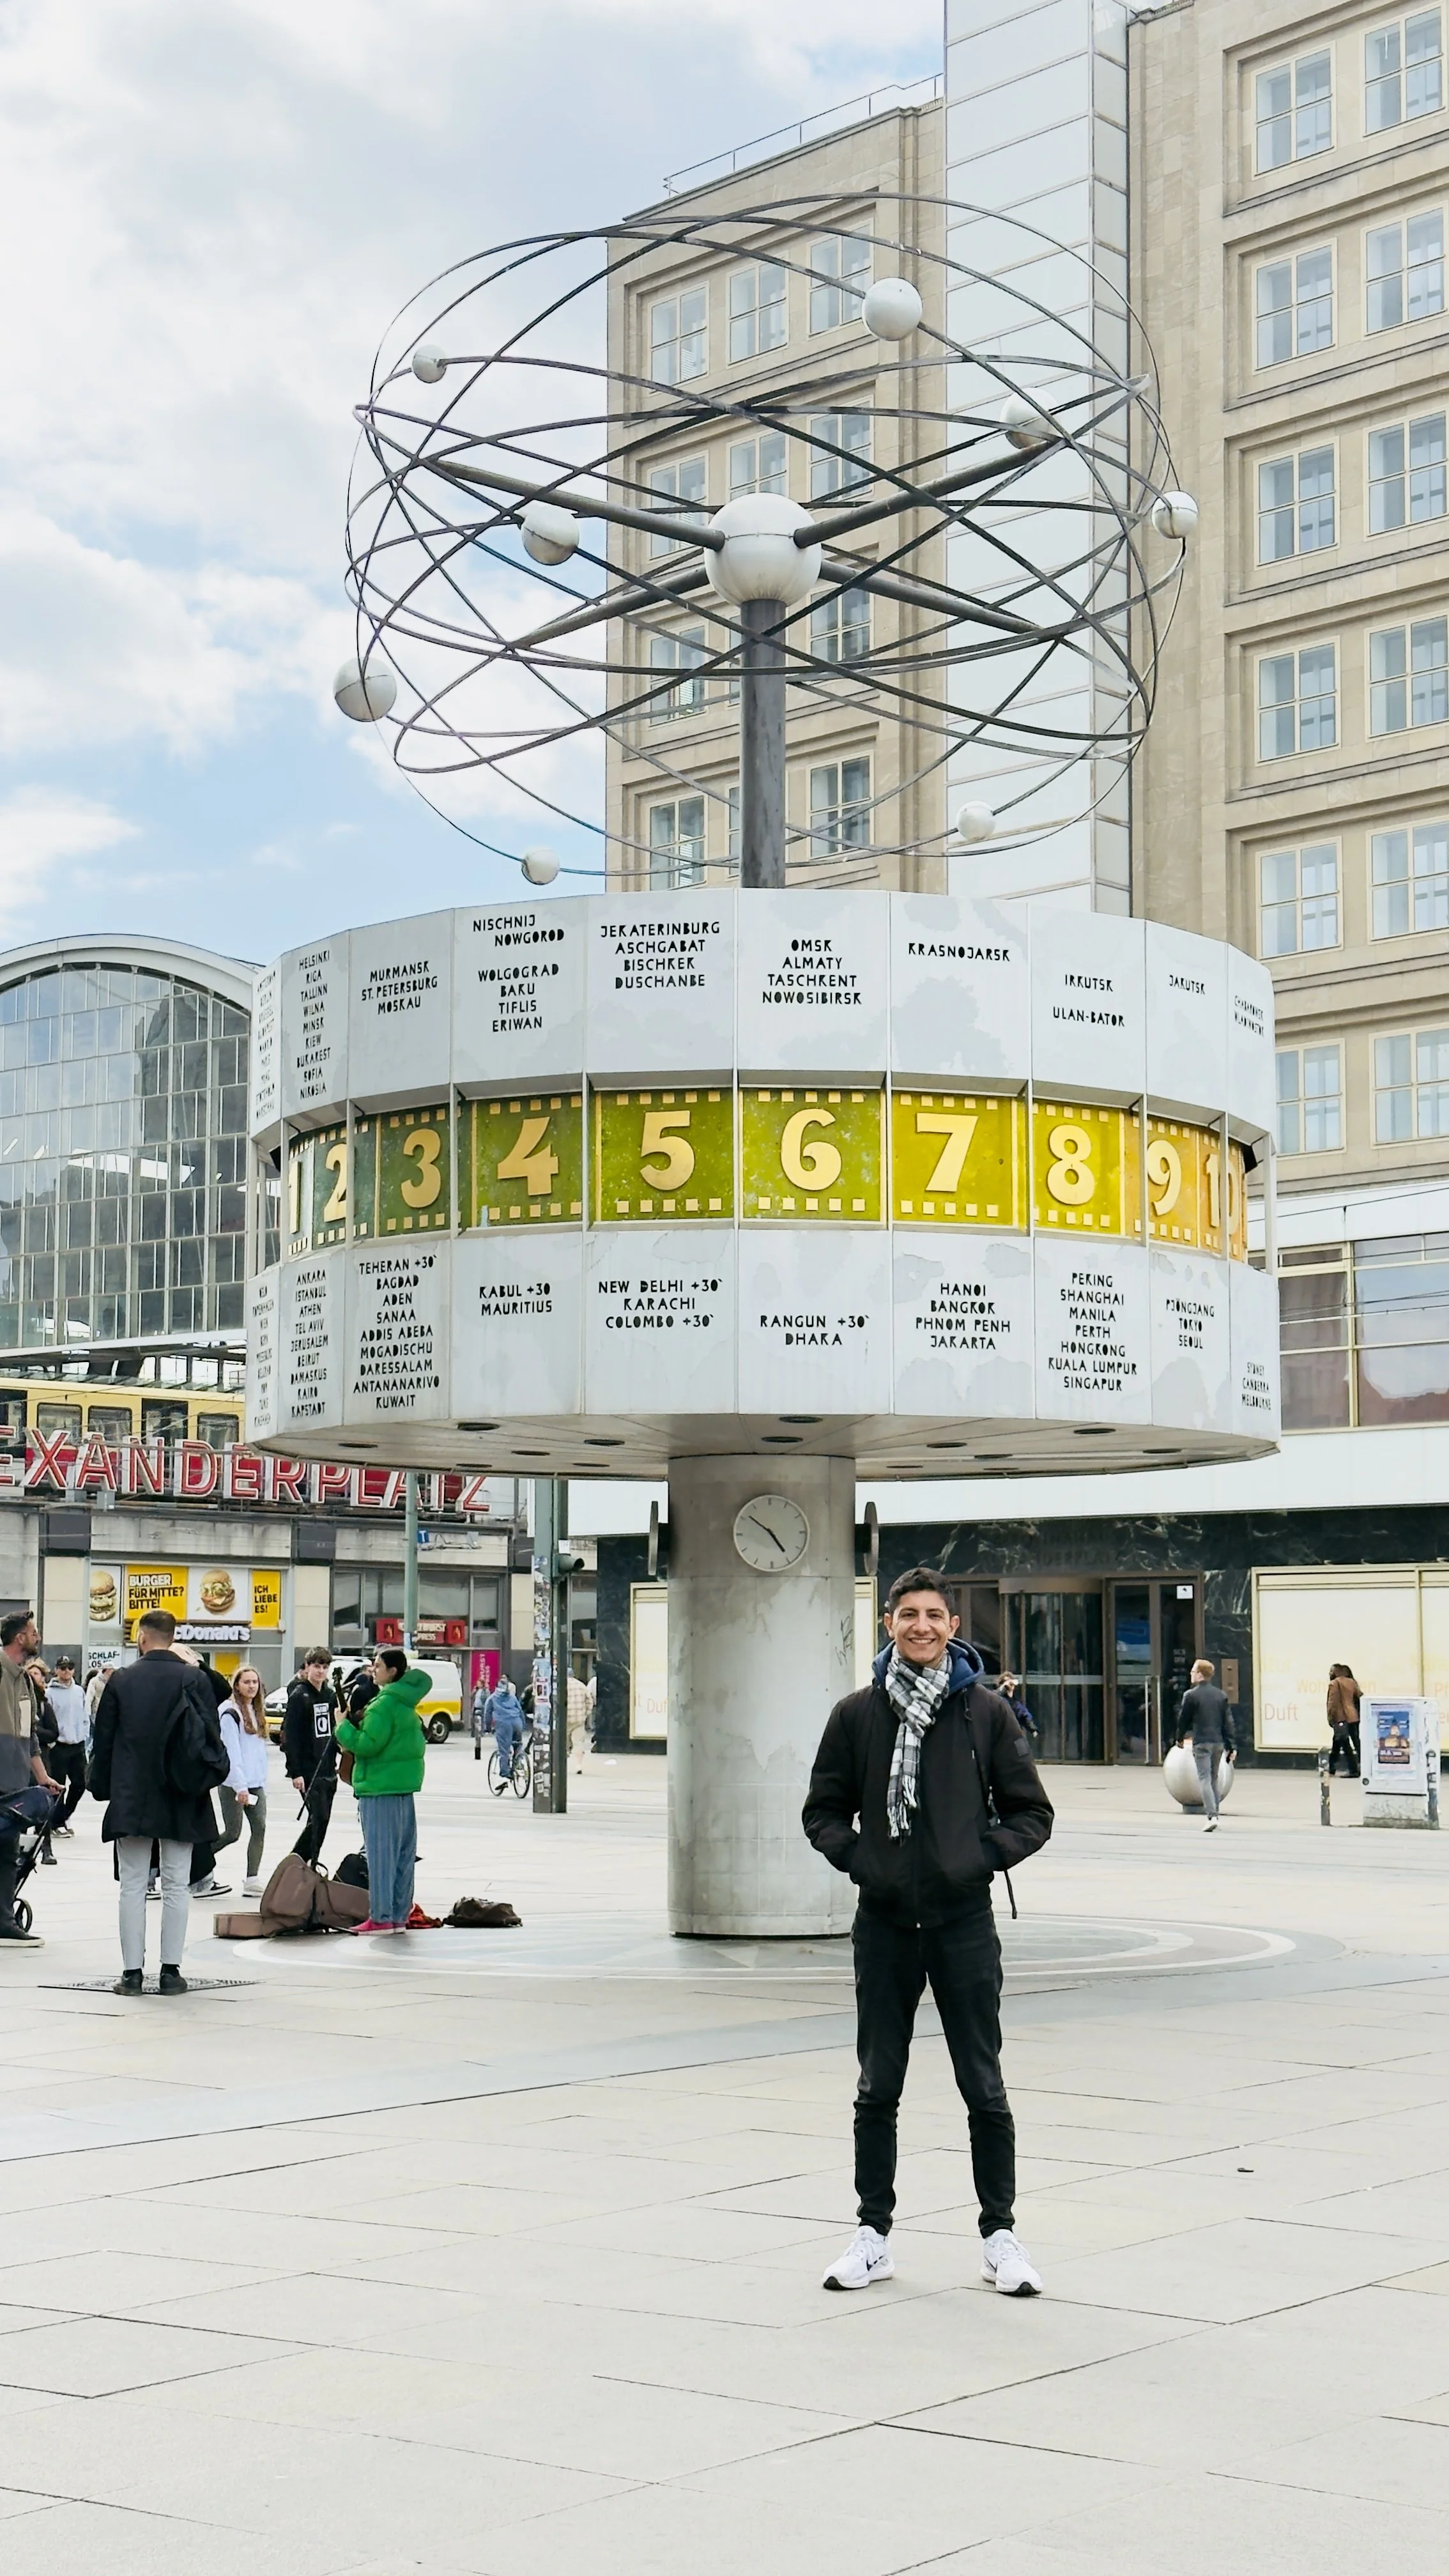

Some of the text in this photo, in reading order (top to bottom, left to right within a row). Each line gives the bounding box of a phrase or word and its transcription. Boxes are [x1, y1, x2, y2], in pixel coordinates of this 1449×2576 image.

[473, 915, 535, 931] NISCHNIJ
[601, 922, 719, 937] JEKATERINBURG
[495, 929, 564, 946] NOWGOROD
[615, 940, 705, 954] ASCHGABAT
[792, 940, 831, 951] OMSK
[909, 943, 1009, 962] KRASNOJARSK
[300, 951, 329, 970] HELSINKI
[624, 957, 694, 971] BISCHKEK
[783, 957, 842, 969] ALMATY
[307, 970, 321, 984] RIGA
[371, 961, 429, 983] MURMANSK
[479, 964, 558, 982] WOLGOGRAD
[362, 976, 437, 1000] ST. PETERSBURG
[616, 975, 705, 989] DUSCHANBE
[768, 974, 857, 987] TASCHKENT
[1066, 975, 1112, 992] IRKUTSK
[1170, 975, 1204, 994] JAKUTSK
[301, 984, 327, 1002] TALLINN
[501, 983, 534, 997] BAKU
[378, 996, 420, 1015] MOSKAU
[763, 992, 861, 1004] NOWOSIBIRSK
[303, 1002, 325, 1017] WILNA
[499, 1000, 536, 1014] TIFLIS
[493, 1016, 542, 1032] ERIWAN
[1054, 1007, 1124, 1027] ULAN-BATOR
[303, 1017, 323, 1034] MINSK
[306, 1034, 321, 1049] KIEW
[297, 1047, 330, 1068] BUKAREST
[304, 1068, 322, 1082] SOFIA
[301, 1083, 326, 1098] NIKOSIA
[498, 1117, 558, 1196] 4
[640, 1110, 695, 1191] 5
[781, 1108, 842, 1191] 6
[917, 1112, 979, 1192] 7
[401, 1128, 441, 1208] 3
[1047, 1124, 1094, 1205] 8
[323, 1143, 346, 1222] 2
[1147, 1140, 1181, 1215] 9
[1205, 1153, 1240, 1236] 10
[360, 1259, 409, 1275] TEHERAN
[298, 1270, 325, 1284] ANKARA
[377, 1275, 418, 1290] BAGDAD
[1073, 1273, 1112, 1287] PEKING
[296, 1287, 326, 1301] ISTANBUL
[480, 1285, 521, 1298] KABUL
[599, 1281, 629, 1293] NEW
[640, 1280, 682, 1292] DELHI
[941, 1283, 985, 1296] HANOI
[383, 1292, 411, 1306] ADEN
[624, 1298, 694, 1310] KARACHI
[1061, 1289, 1123, 1305] SHANGHAI
[300, 1303, 321, 1317] ATHEN
[482, 1300, 551, 1315] MAURITIUS
[931, 1300, 995, 1314] BANGKOK
[1070, 1307, 1116, 1321] MANILA
[1167, 1300, 1214, 1317] PJÖNGJANG
[377, 1309, 415, 1324] SANAA
[606, 1315, 673, 1328] COLOMBO
[761, 1315, 825, 1328] RANGUN
[296, 1319, 323, 1334] TEL AVIV
[916, 1317, 1009, 1332] PHNOM PENH
[1076, 1325, 1110, 1338] PERTH
[1179, 1318, 1202, 1331] TOKYO
[360, 1325, 433, 1342] ADDIS ABEBA
[786, 1333, 842, 1346] DHAKA
[291, 1335, 328, 1352] JERUSALEM
[931, 1335, 995, 1349] JAKARTA
[1062, 1342, 1124, 1357] HONGKONG
[1179, 1335, 1202, 1349] SEOUL
[361, 1342, 432, 1359] MOGADISCHU
[298, 1353, 319, 1367] BEIRUT
[360, 1359, 432, 1376] DARESSALAM
[1049, 1358, 1137, 1375] KUALA LUMPUR
[291, 1368, 326, 1384] DAMASKUS
[1064, 1376, 1121, 1391] SINGAPUR
[353, 1376, 439, 1393] ANTANANARIVO
[298, 1386, 318, 1399] KAIRO
[376, 1395, 415, 1409] KUWAIT
[292, 1402, 325, 1418] KAPSTADT
[129, 1574, 171, 1586] BURGER
[129, 1587, 184, 1598] FÜR MITTE?
[255, 1594, 277, 1603] LIEBE
[129, 1598, 160, 1609] BITTE!
[173, 1625, 250, 1641] cDonald's
[1264, 1702, 1298, 1721] Duft
